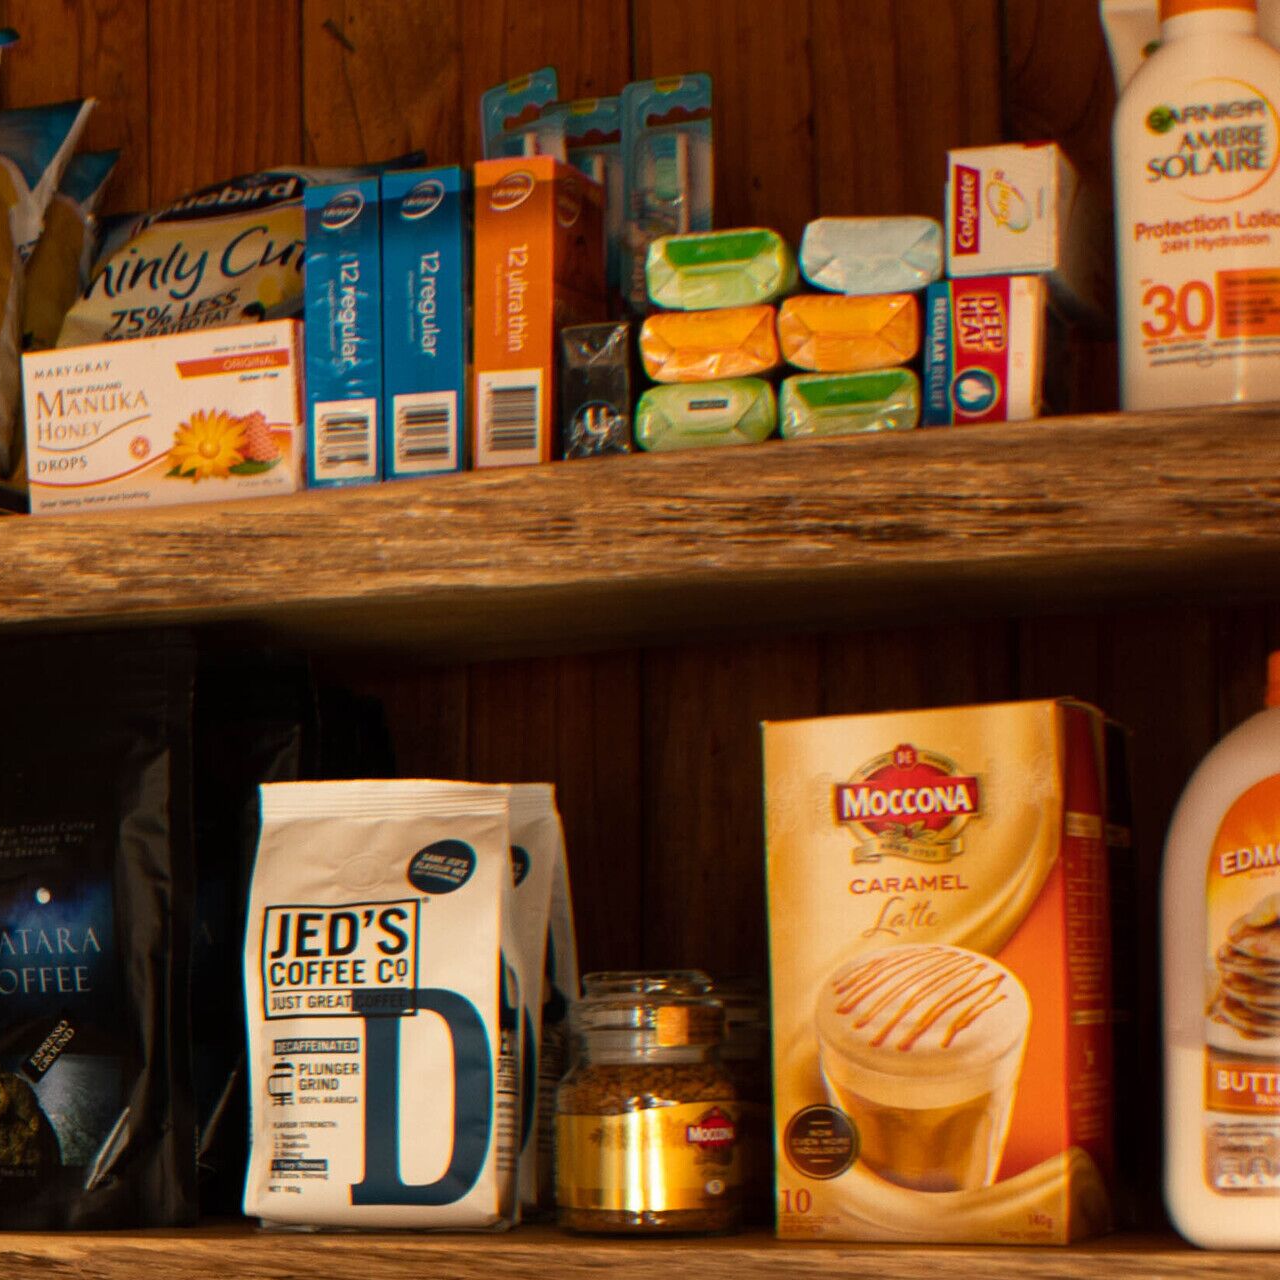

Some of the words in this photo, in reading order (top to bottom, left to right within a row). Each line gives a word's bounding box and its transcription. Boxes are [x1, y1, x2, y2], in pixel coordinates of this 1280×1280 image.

[1146, 100, 1265, 134] GARNIER
[1182, 126, 1266, 151] AMBRE
[1146, 148, 1267, 182] SOLAIRE
[955, 173, 977, 254] Colgate
[1135, 215, 1230, 241] Protection
[507, 242, 528, 265] 12
[1195, 234, 1270, 251] Hydration
[419, 250, 439, 271] 12
[418, 275, 439, 358] regular
[957, 284, 981, 350] HEAT
[982, 282, 1006, 352] DEEP
[1142, 279, 1215, 340] 30
[339, 287, 359, 368] regular
[928, 297, 948, 362] REGULAR
[36, 388, 149, 420] MANUKA
[38, 421, 102, 442] HONEY
[37, 456, 88, 473] DROPS
[841, 783, 974, 823] MOCCONA
[849, 875, 969, 894] CARAMEL
[863, 897, 940, 938] Latte
[270, 907, 409, 959] JED'S
[270, 959, 366, 987] COFFEE
[272, 994, 302, 1011] JUST
[307, 993, 351, 1010] GREAT
[274, 1039, 358, 1054] DECAFFEINATED
[299, 1062, 360, 1077] PLUNGER
[299, 1077, 340, 1091] GRIND
[350, 987, 494, 1206] D
[781, 1190, 812, 1214] 10
